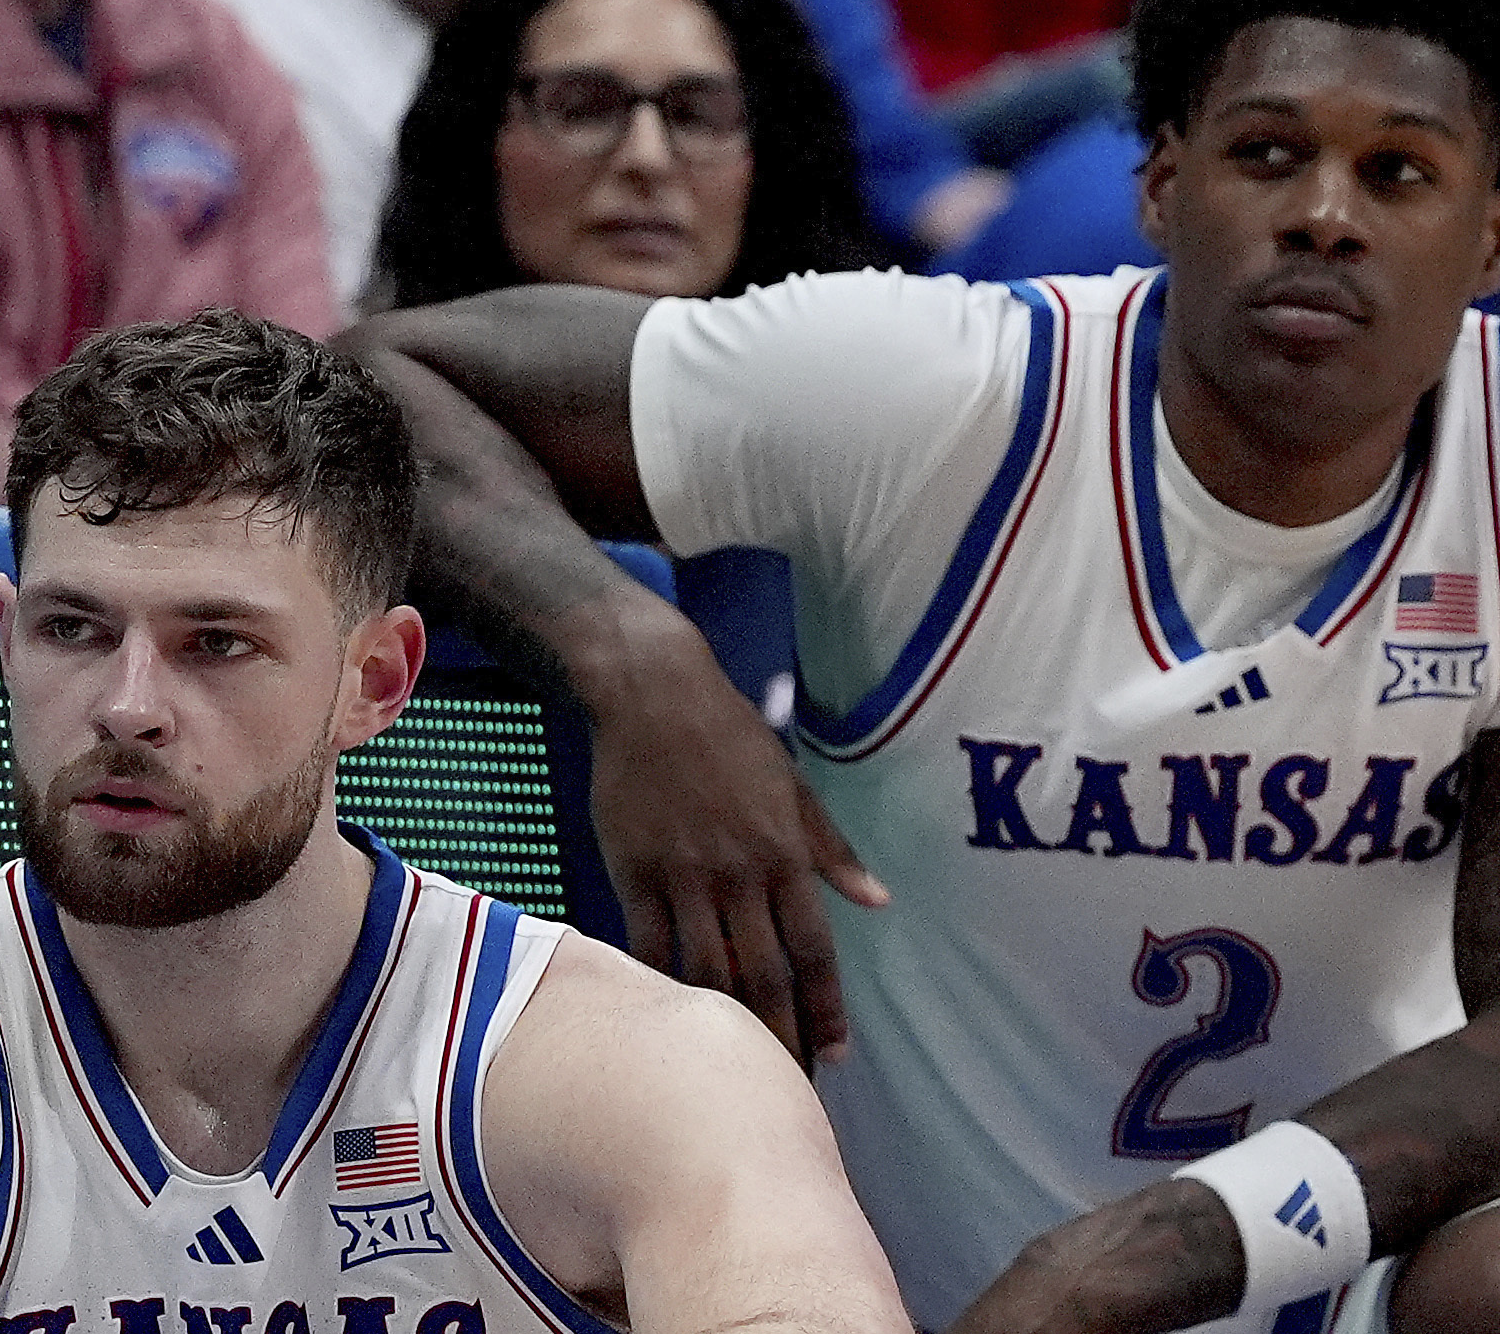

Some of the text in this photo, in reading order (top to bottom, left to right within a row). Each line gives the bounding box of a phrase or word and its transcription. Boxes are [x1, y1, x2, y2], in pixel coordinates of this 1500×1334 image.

[958, 735, 1470, 868] KANSAS
[1111, 926, 1282, 1161] 2
[328, 1191, 454, 1272] XII
